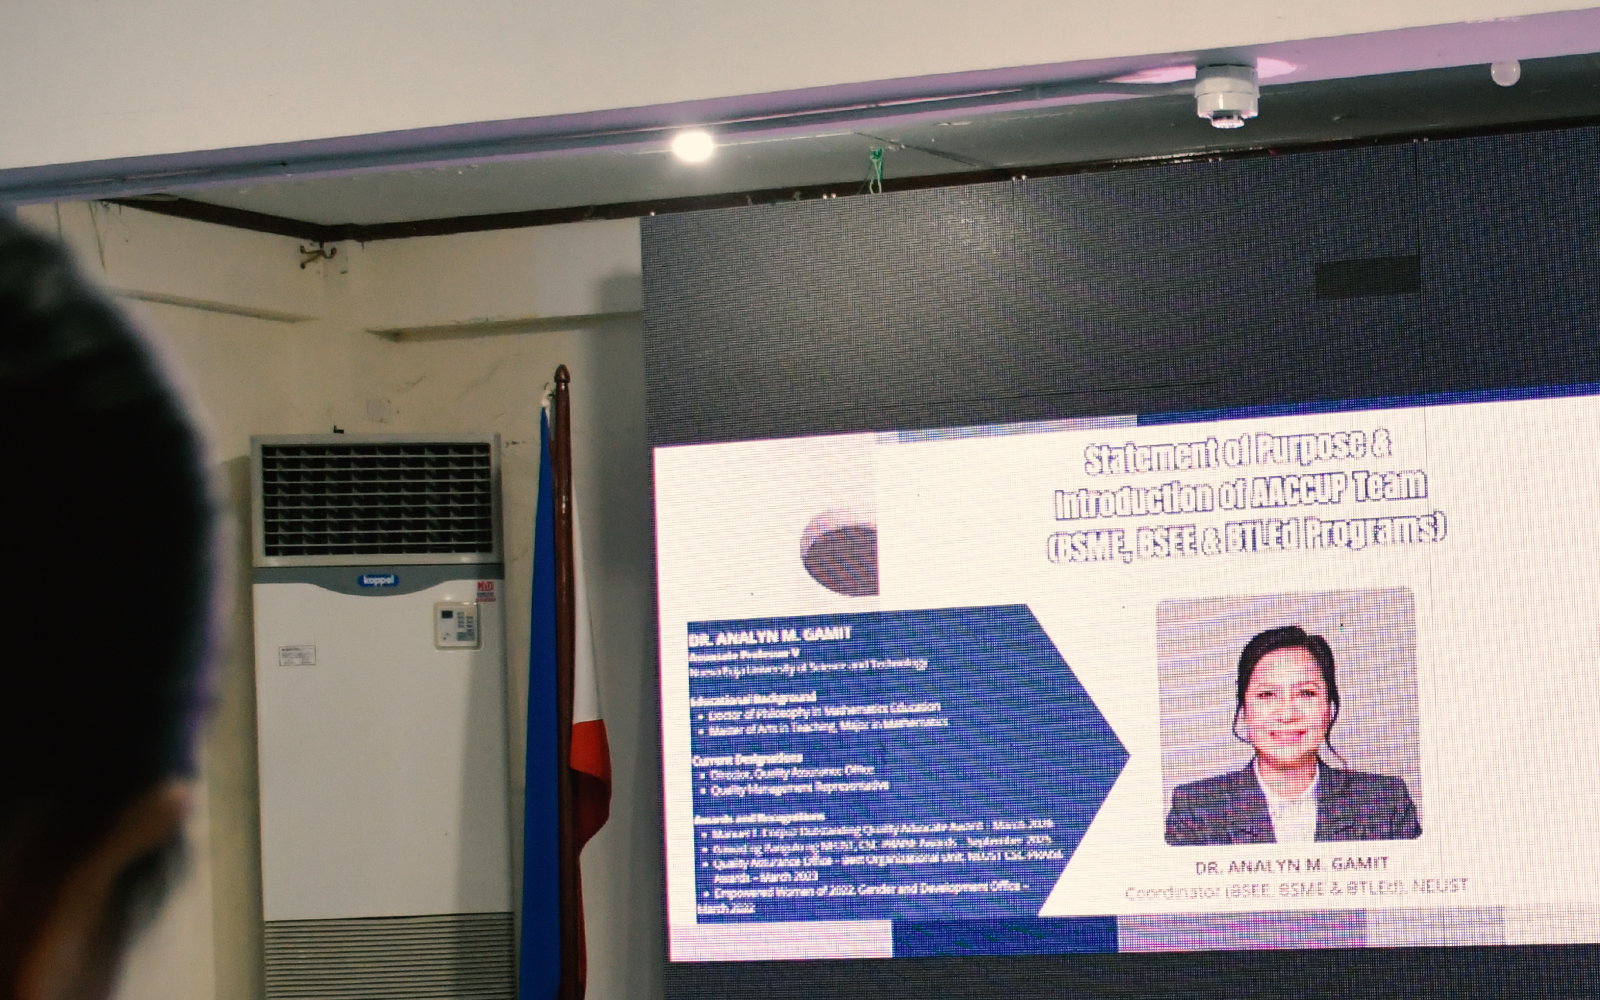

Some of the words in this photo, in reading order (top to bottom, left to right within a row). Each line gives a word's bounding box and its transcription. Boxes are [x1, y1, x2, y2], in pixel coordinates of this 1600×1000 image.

[1084, 436, 1219, 477] Statement
[1222, 432, 1251, 468] of
[1256, 430, 1367, 467] Purpose
[1371, 427, 1393, 459] &
[1054, 480, 1214, 521] Introduction
[1218, 477, 1247, 511] of
[1250, 471, 1348, 510] AACCUP
[1352, 469, 1429, 503] Team
[1047, 528, 1133, 565] (BSME,
[1136, 523, 1198, 560] BSEE
[1201, 526, 1222, 557] &
[1224, 518, 1300, 553] BTLEd
[1304, 510, 1448, 551] Programs)
[363, 574, 395, 587] koppel
[688, 633, 714, 648] DR.
[715, 631, 779, 646] ANALYN
[780, 629, 801, 642] M.
[802, 626, 853, 642] GAMIT
[1196, 860, 1224, 876] DR.
[1228, 858, 1301, 875] ANALYN
[1305, 857, 1328, 872] M.
[1331, 856, 1390, 872] GAMIT
